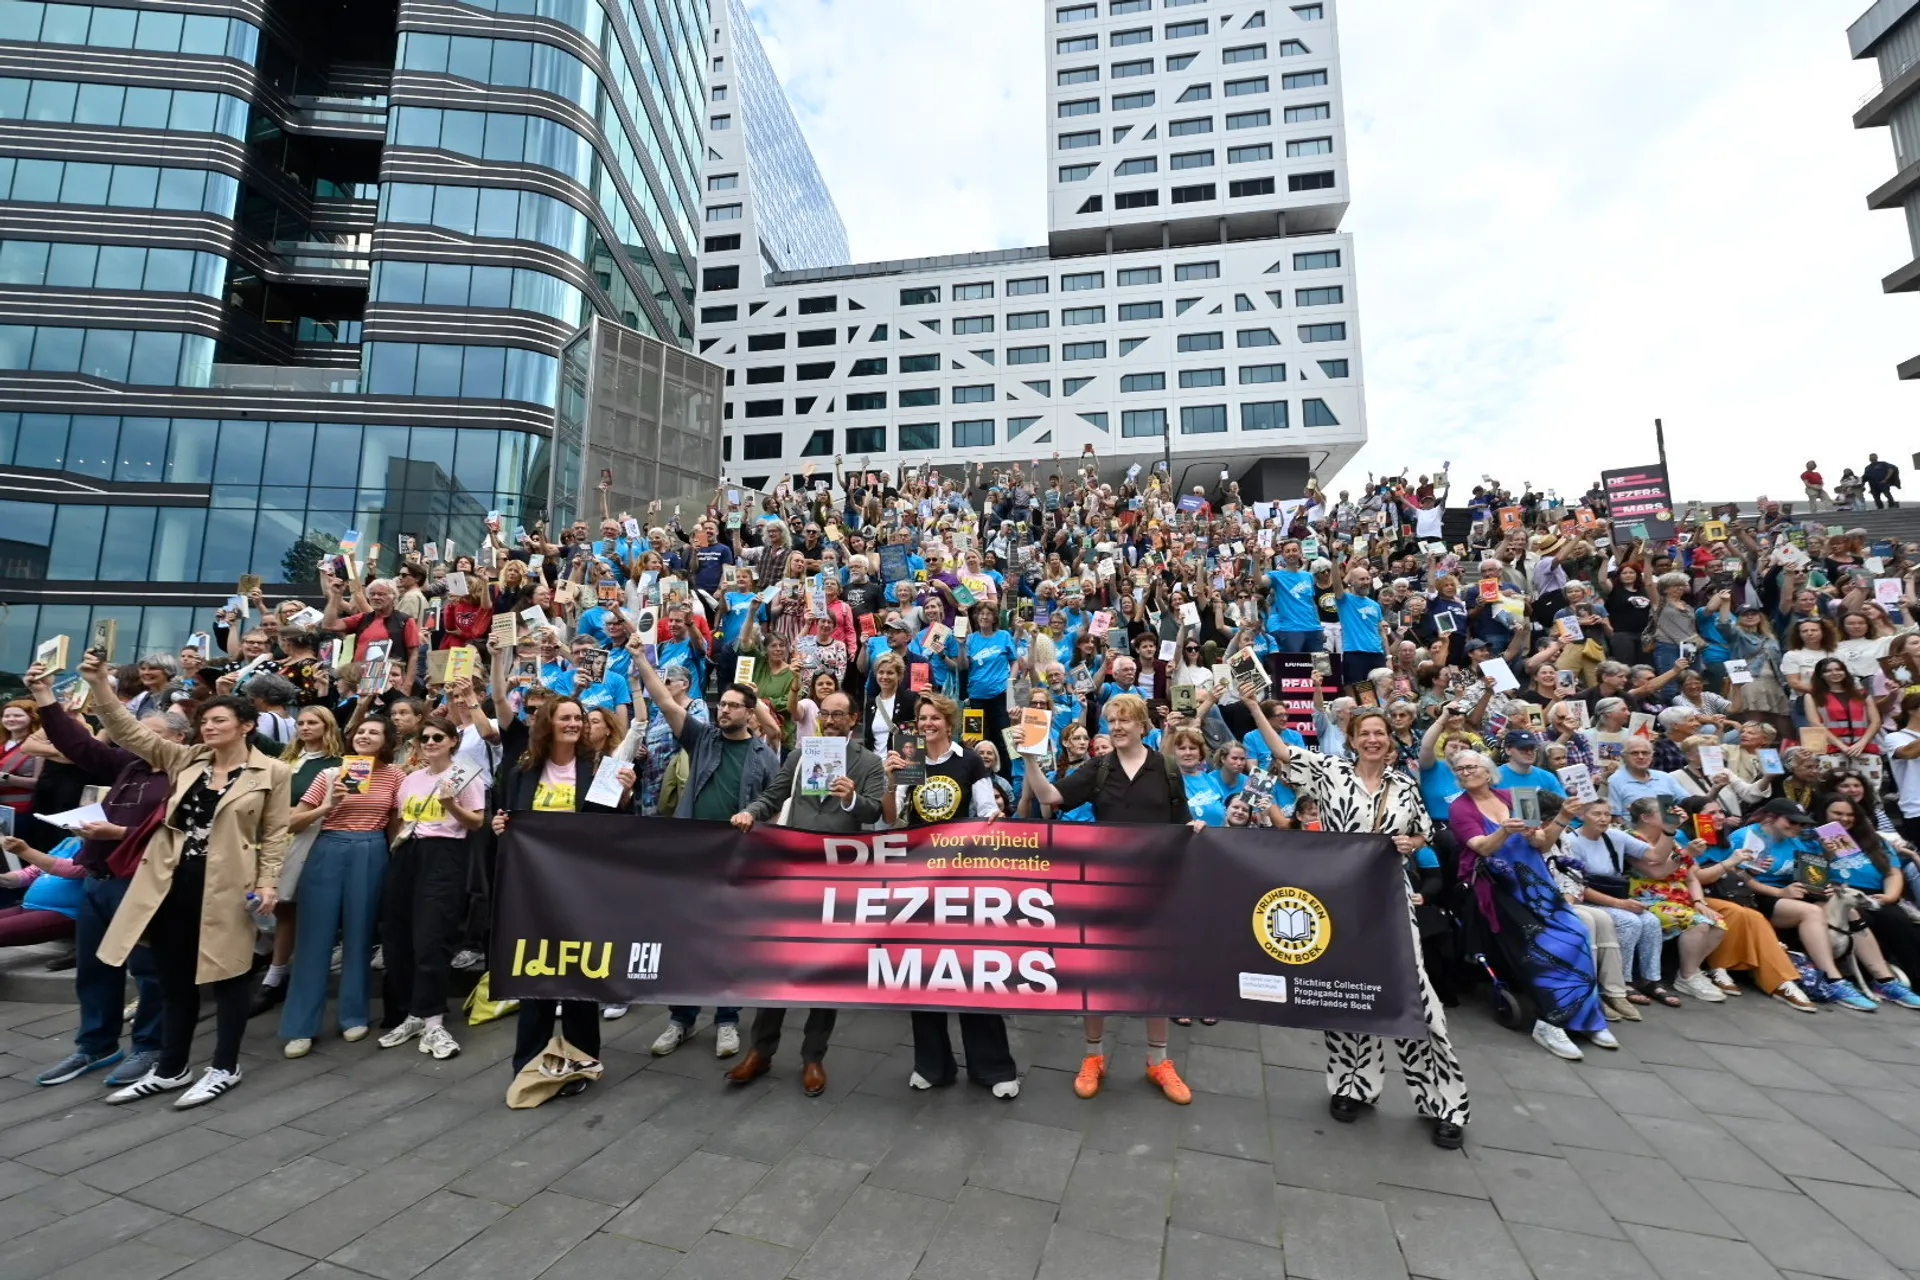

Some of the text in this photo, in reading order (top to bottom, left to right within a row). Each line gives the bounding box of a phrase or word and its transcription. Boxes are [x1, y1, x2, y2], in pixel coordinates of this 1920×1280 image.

[1610, 487, 1661, 500] LEZERS
[1623, 502, 1664, 513] MARS
[823, 834, 908, 867] DE
[930, 830, 1040, 851] Voor vrijheid
[927, 852, 1051, 871] en democratie
[821, 887, 1056, 929] LEZERS
[1256, 889, 1326, 920] VRIJHEID IS EEN
[512, 938, 612, 979] ILFU
[627, 942, 662, 973] PEN
[1264, 941, 1323, 963] OPEN BOEK
[626, 972, 658, 980] NEDERLAND
[867, 948, 1058, 995] MARS
[1293, 977, 1332, 989] Stichting
[1333, 980, 1382, 992] Collectieve
[1294, 986, 1343, 998] Propaganda
[1361, 992, 1375, 1001] het
[1294, 996, 1372, 1010] Nederlandse Boek
